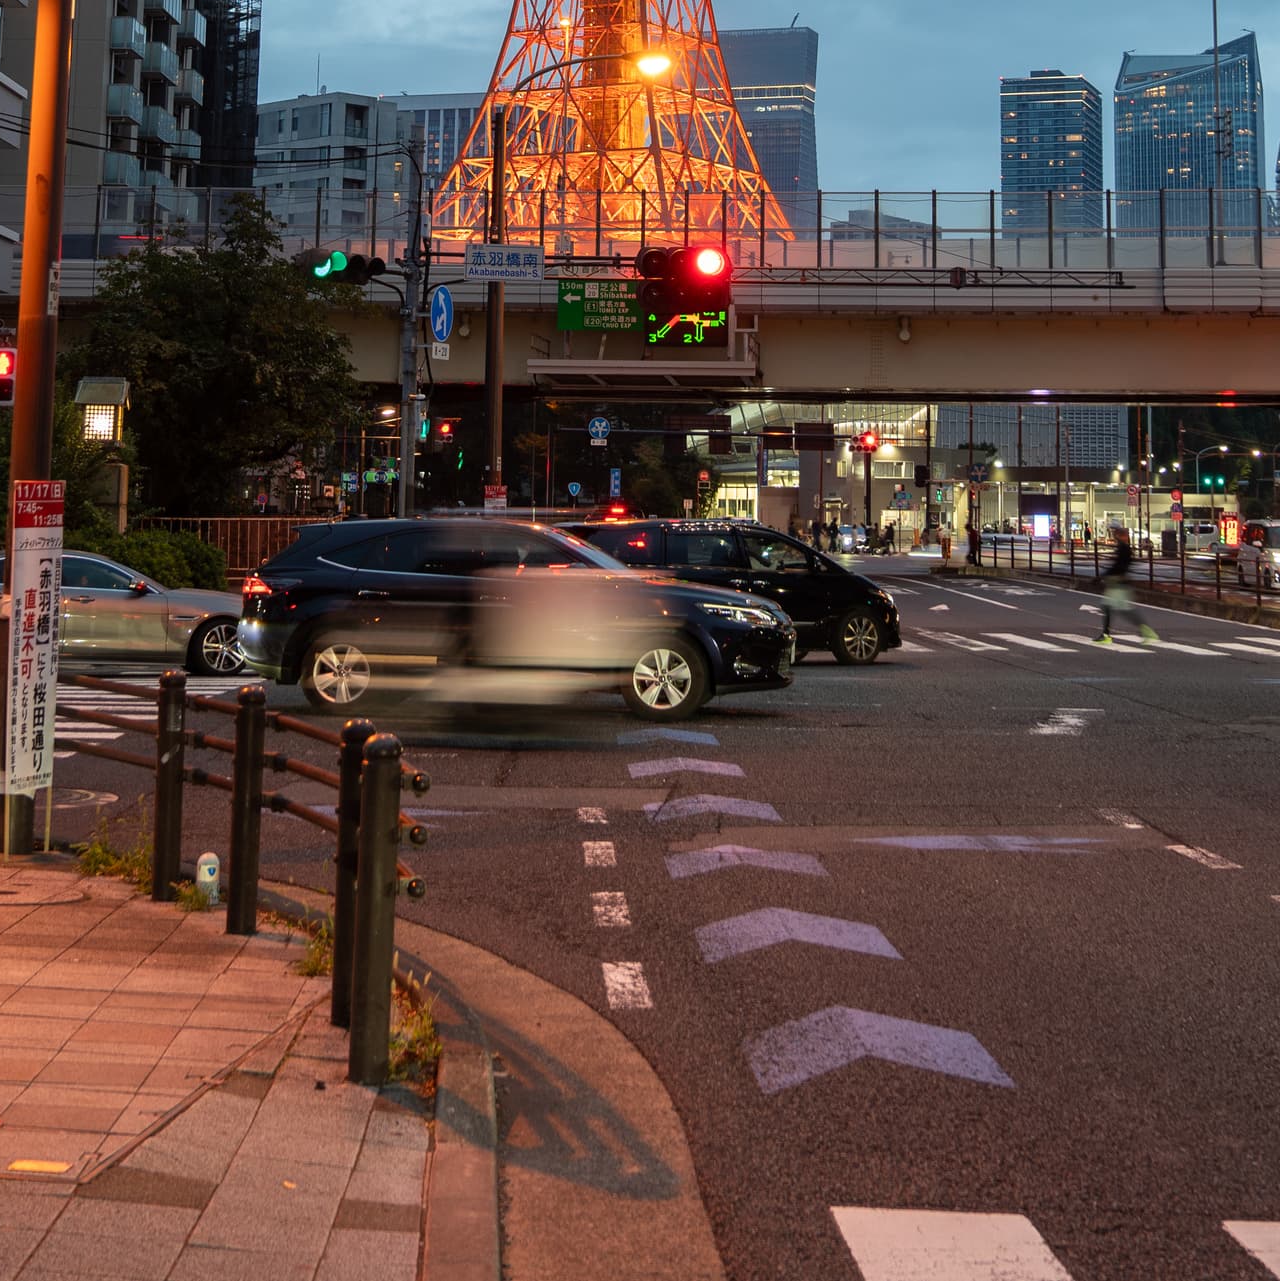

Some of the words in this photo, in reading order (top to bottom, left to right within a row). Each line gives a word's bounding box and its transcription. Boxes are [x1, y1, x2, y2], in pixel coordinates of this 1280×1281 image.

[471, 251, 539, 268] 赤羽橋南
[560, 282, 584, 290] 150m
[599, 283, 628, 292] 芝公園
[648, 333, 657, 343] 3
[683, 333, 693, 343] 2
